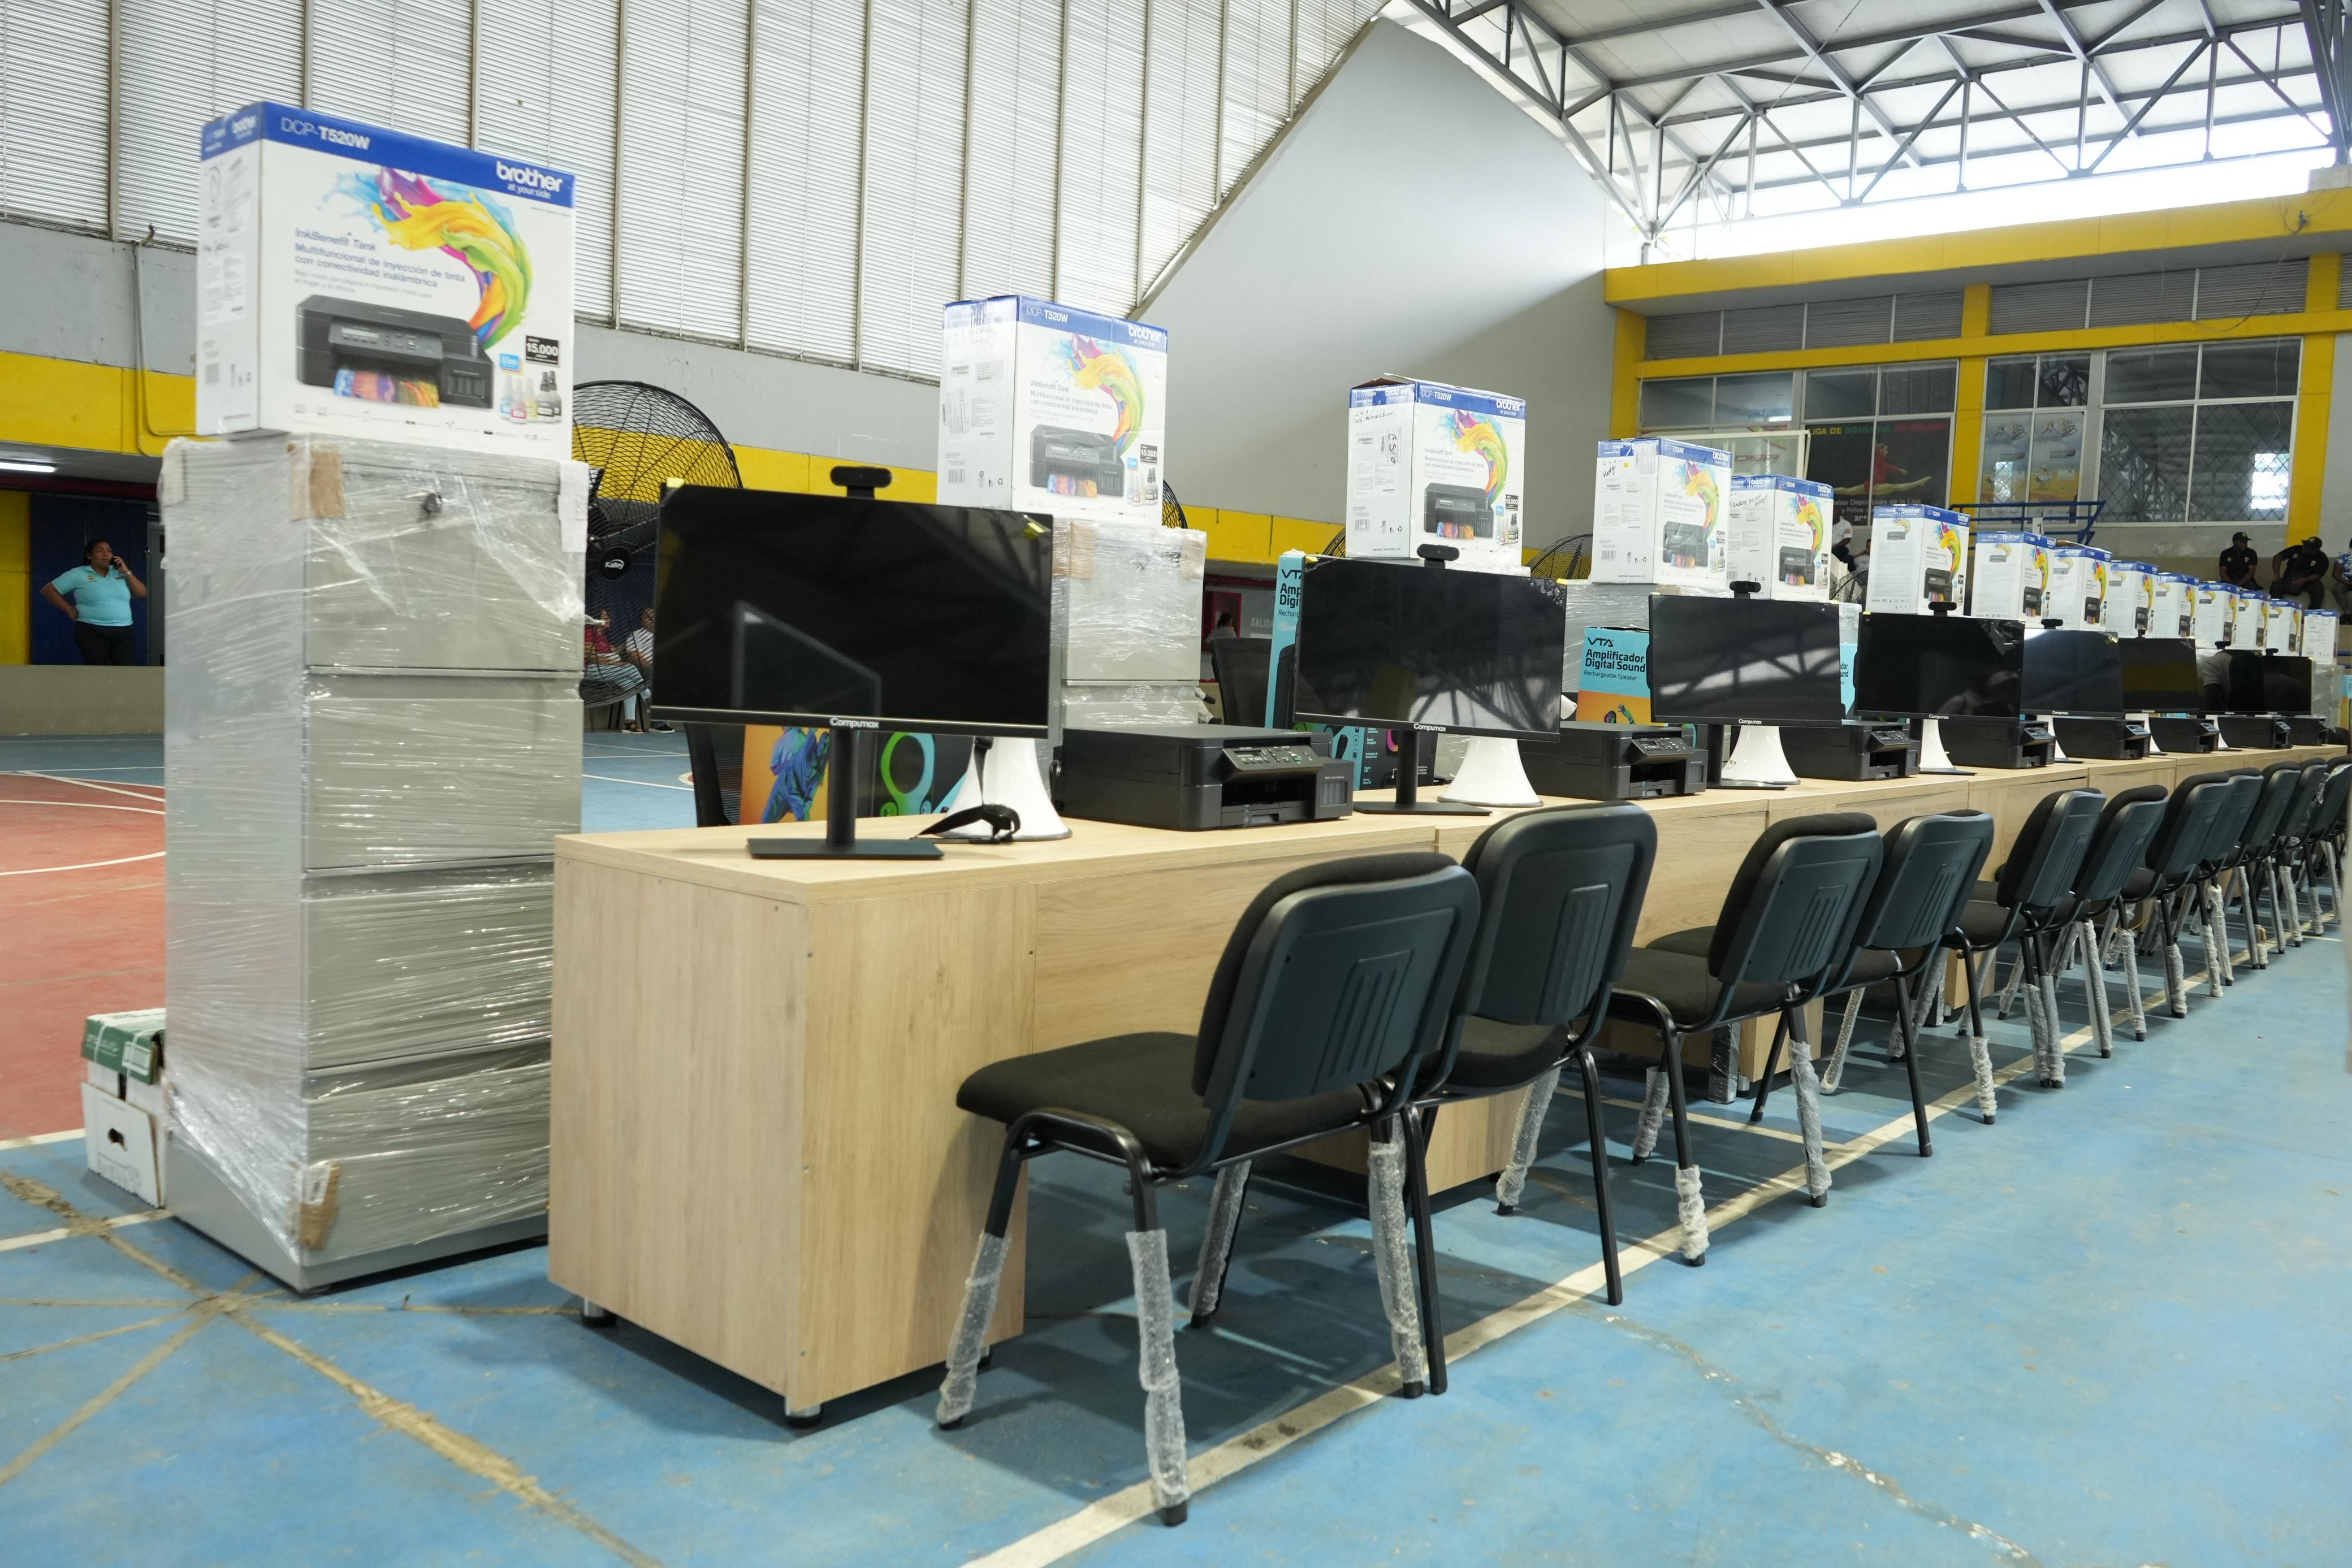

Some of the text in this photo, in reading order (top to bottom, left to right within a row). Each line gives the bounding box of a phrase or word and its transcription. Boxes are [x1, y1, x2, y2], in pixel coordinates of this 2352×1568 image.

[280, 116, 371, 150] DCP-T520W
[496, 161, 563, 192] brother
[1027, 305, 1069, 323] DCP-T520W
[1128, 323, 1163, 343] brother
[526, 343, 559, 357] 15.000
[1031, 380, 1057, 391] InkBenefit
[1031, 390, 1064, 401] Multifuncional
[1385, 387, 1408, 396] brother
[1421, 389, 1452, 401] DCP-T520W
[1040, 400, 1071, 410] conectividad
[1496, 398, 1521, 412] brother
[1140, 449, 1157, 458] 15.000
[1713, 451, 1730, 462] brother
[1818, 484, 1831, 493] brother
[1281, 569, 1302, 579] VT
[1279, 594, 1301, 609] Digi
[1587, 637, 1614, 647] VTA
[1585, 648, 1645, 663] Amplificador
[1585, 657, 1646, 673] Digital Sound
[1584, 670, 1617, 679] Rechargeable
[829, 717, 880, 729] Compumax
[1413, 723, 1446, 732] Compumax
